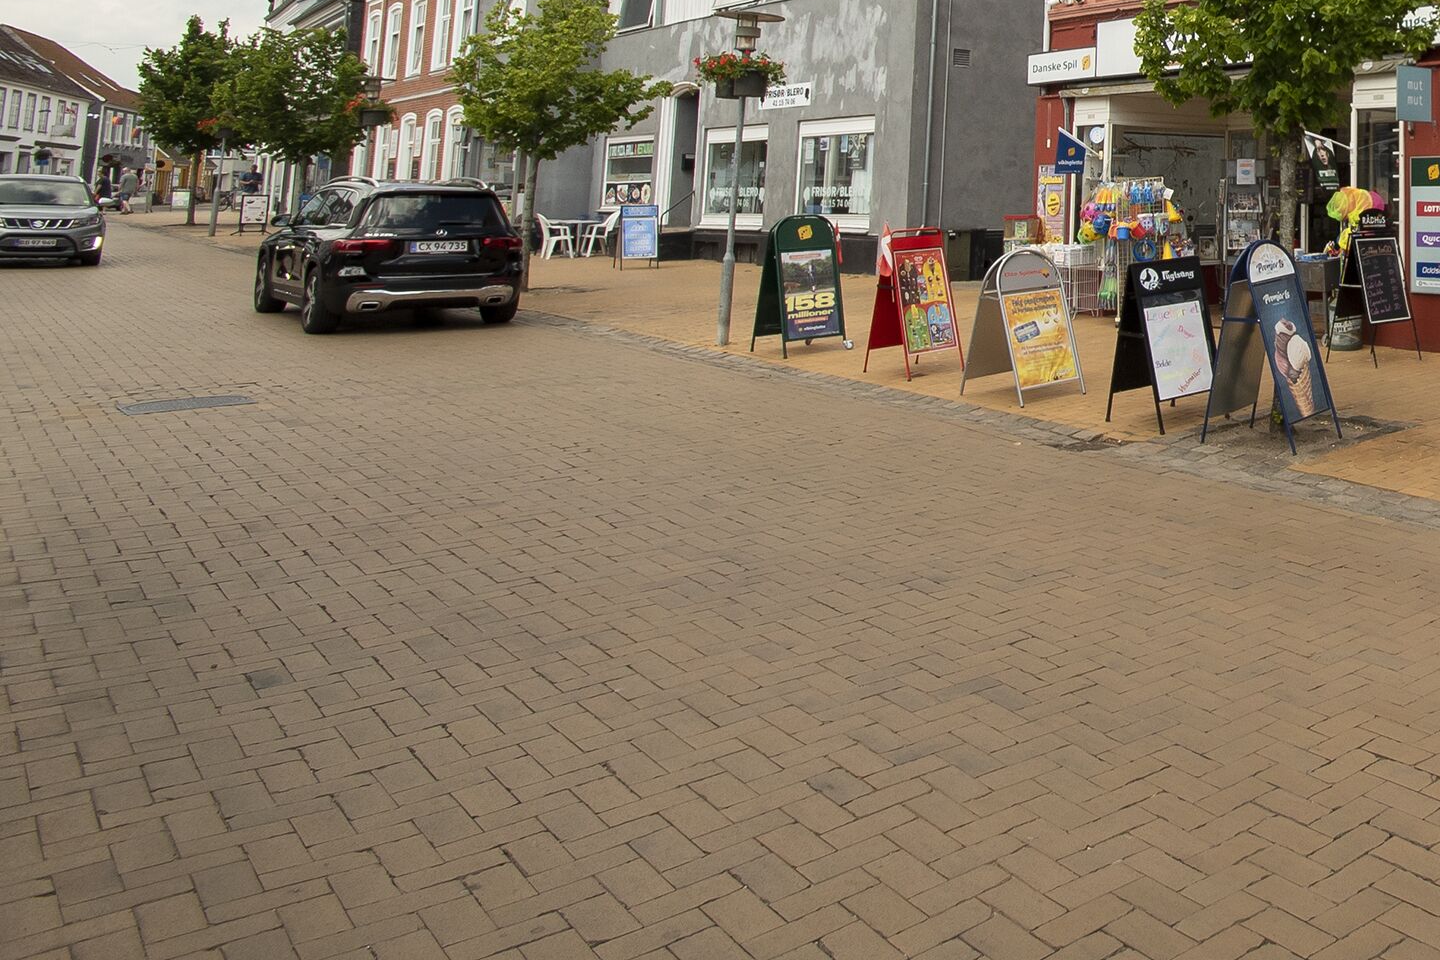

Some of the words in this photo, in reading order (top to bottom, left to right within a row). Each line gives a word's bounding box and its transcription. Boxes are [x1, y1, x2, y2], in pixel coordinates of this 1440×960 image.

[1032, 63, 1062, 73] Danske
[1063, 60, 1078, 72] Spil
[1407, 80, 1424, 91] mut
[786, 87, 804, 97] BLERO
[1407, 96, 1424, 106] mut
[418, 242, 431, 251] CX
[434, 242, 447, 250] 94
[449, 242, 466, 250] 735
[1161, 270, 1195, 282] Fuglsang
[785, 292, 836, 312] 158
[787, 309, 834, 320] millioner
